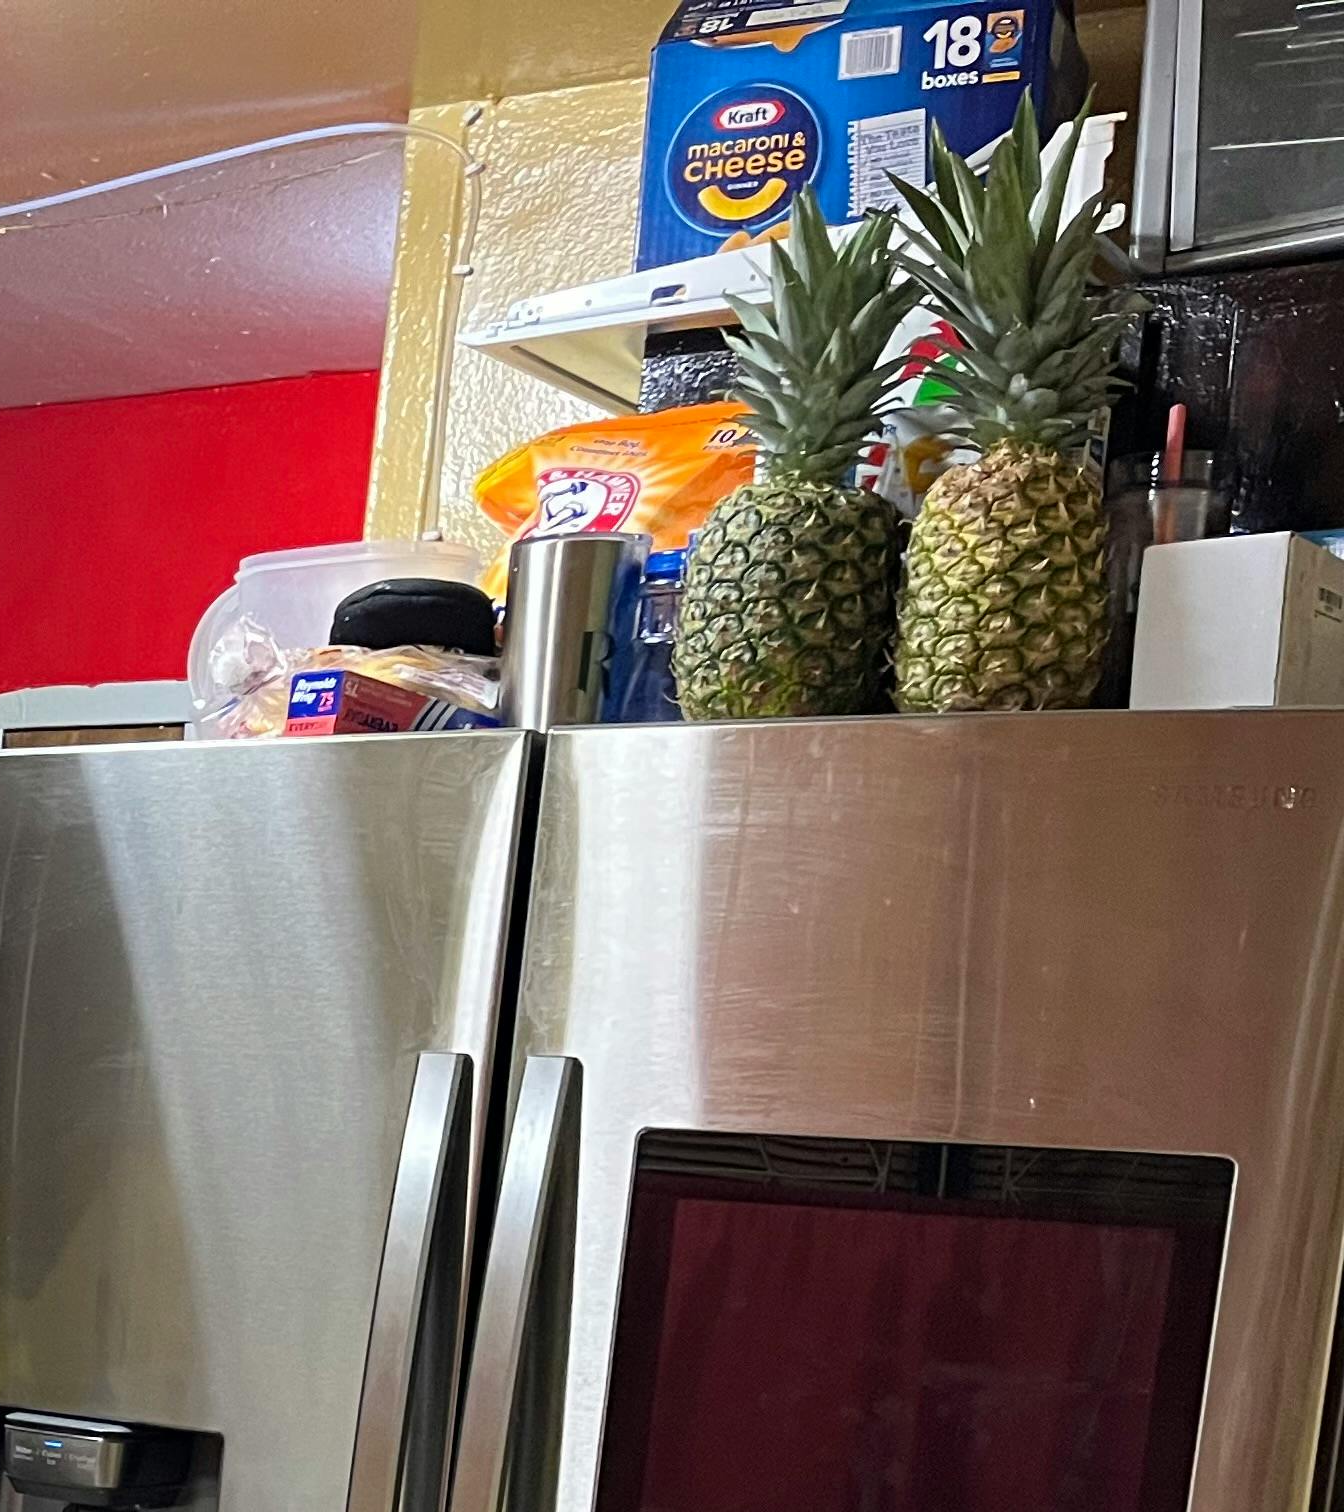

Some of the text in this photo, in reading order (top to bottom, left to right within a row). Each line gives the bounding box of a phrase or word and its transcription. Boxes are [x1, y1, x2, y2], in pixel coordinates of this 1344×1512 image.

[922, 15, 982, 69] 18
[921, 70, 979, 90] boxes
[727, 106, 768, 126] Kraft
[687, 131, 806, 161] macaroni &
